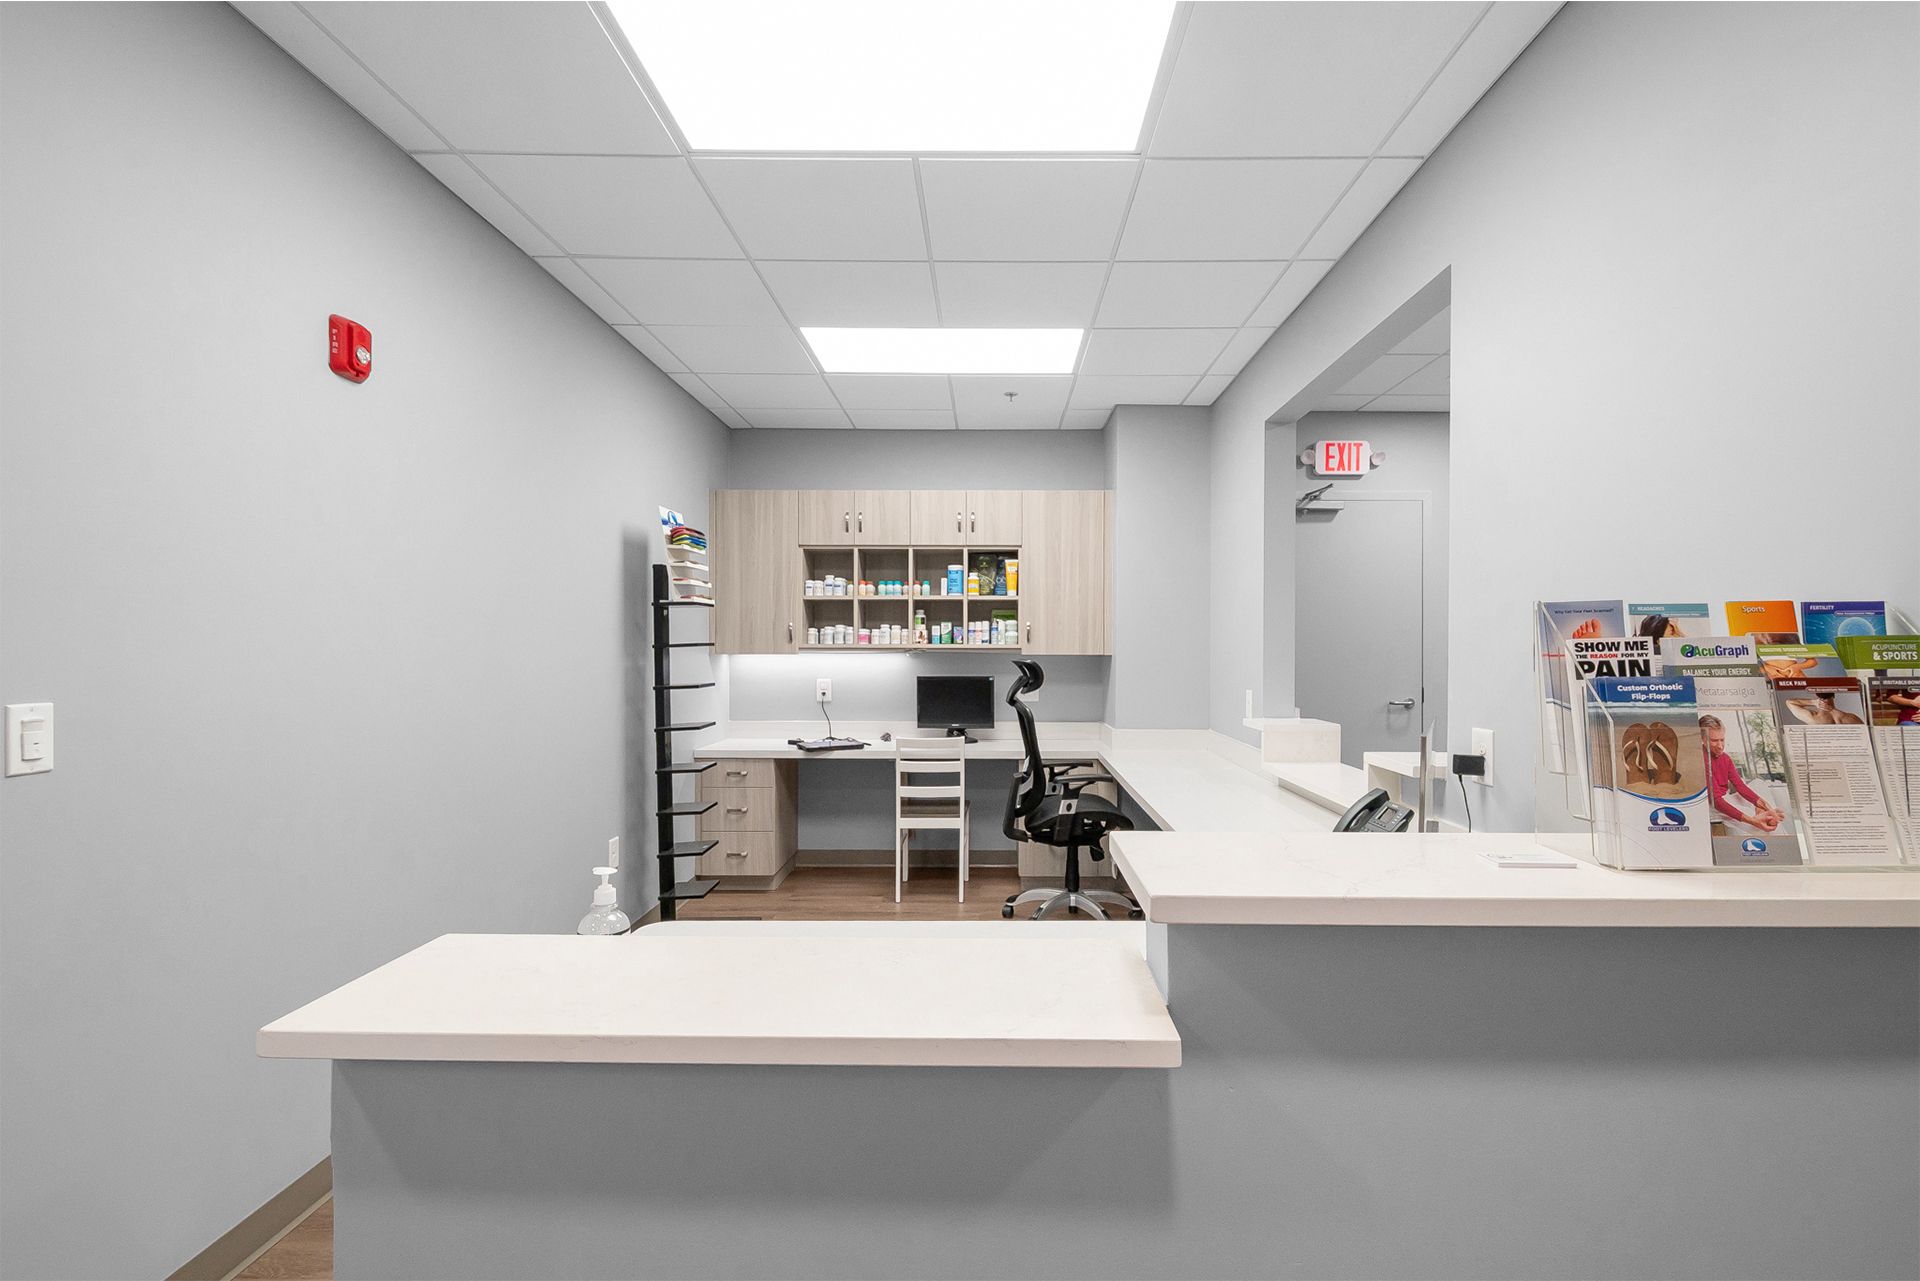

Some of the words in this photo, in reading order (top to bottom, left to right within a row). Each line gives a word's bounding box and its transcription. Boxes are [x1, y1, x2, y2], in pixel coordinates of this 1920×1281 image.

[1325, 442, 1363, 472] EXIT
[1742, 605, 1766, 613] Sports
[1574, 642, 1621, 653] SHOW
[1625, 640, 1649, 651] ME
[1694, 645, 1749, 658] AcuGraph
[1873, 651, 1882, 661] &
[1882, 651, 1918, 661] SPORTS
[1577, 659, 1651, 678] PAIN
[1682, 668, 1711, 677] BALANCE
[1711, 668, 1728, 676] YOUR
[1649, 683, 1683, 691] Orthotic
[1631, 692, 1671, 700] Flip-Flops
[1696, 687, 1756, 698] Metatarsalgia
